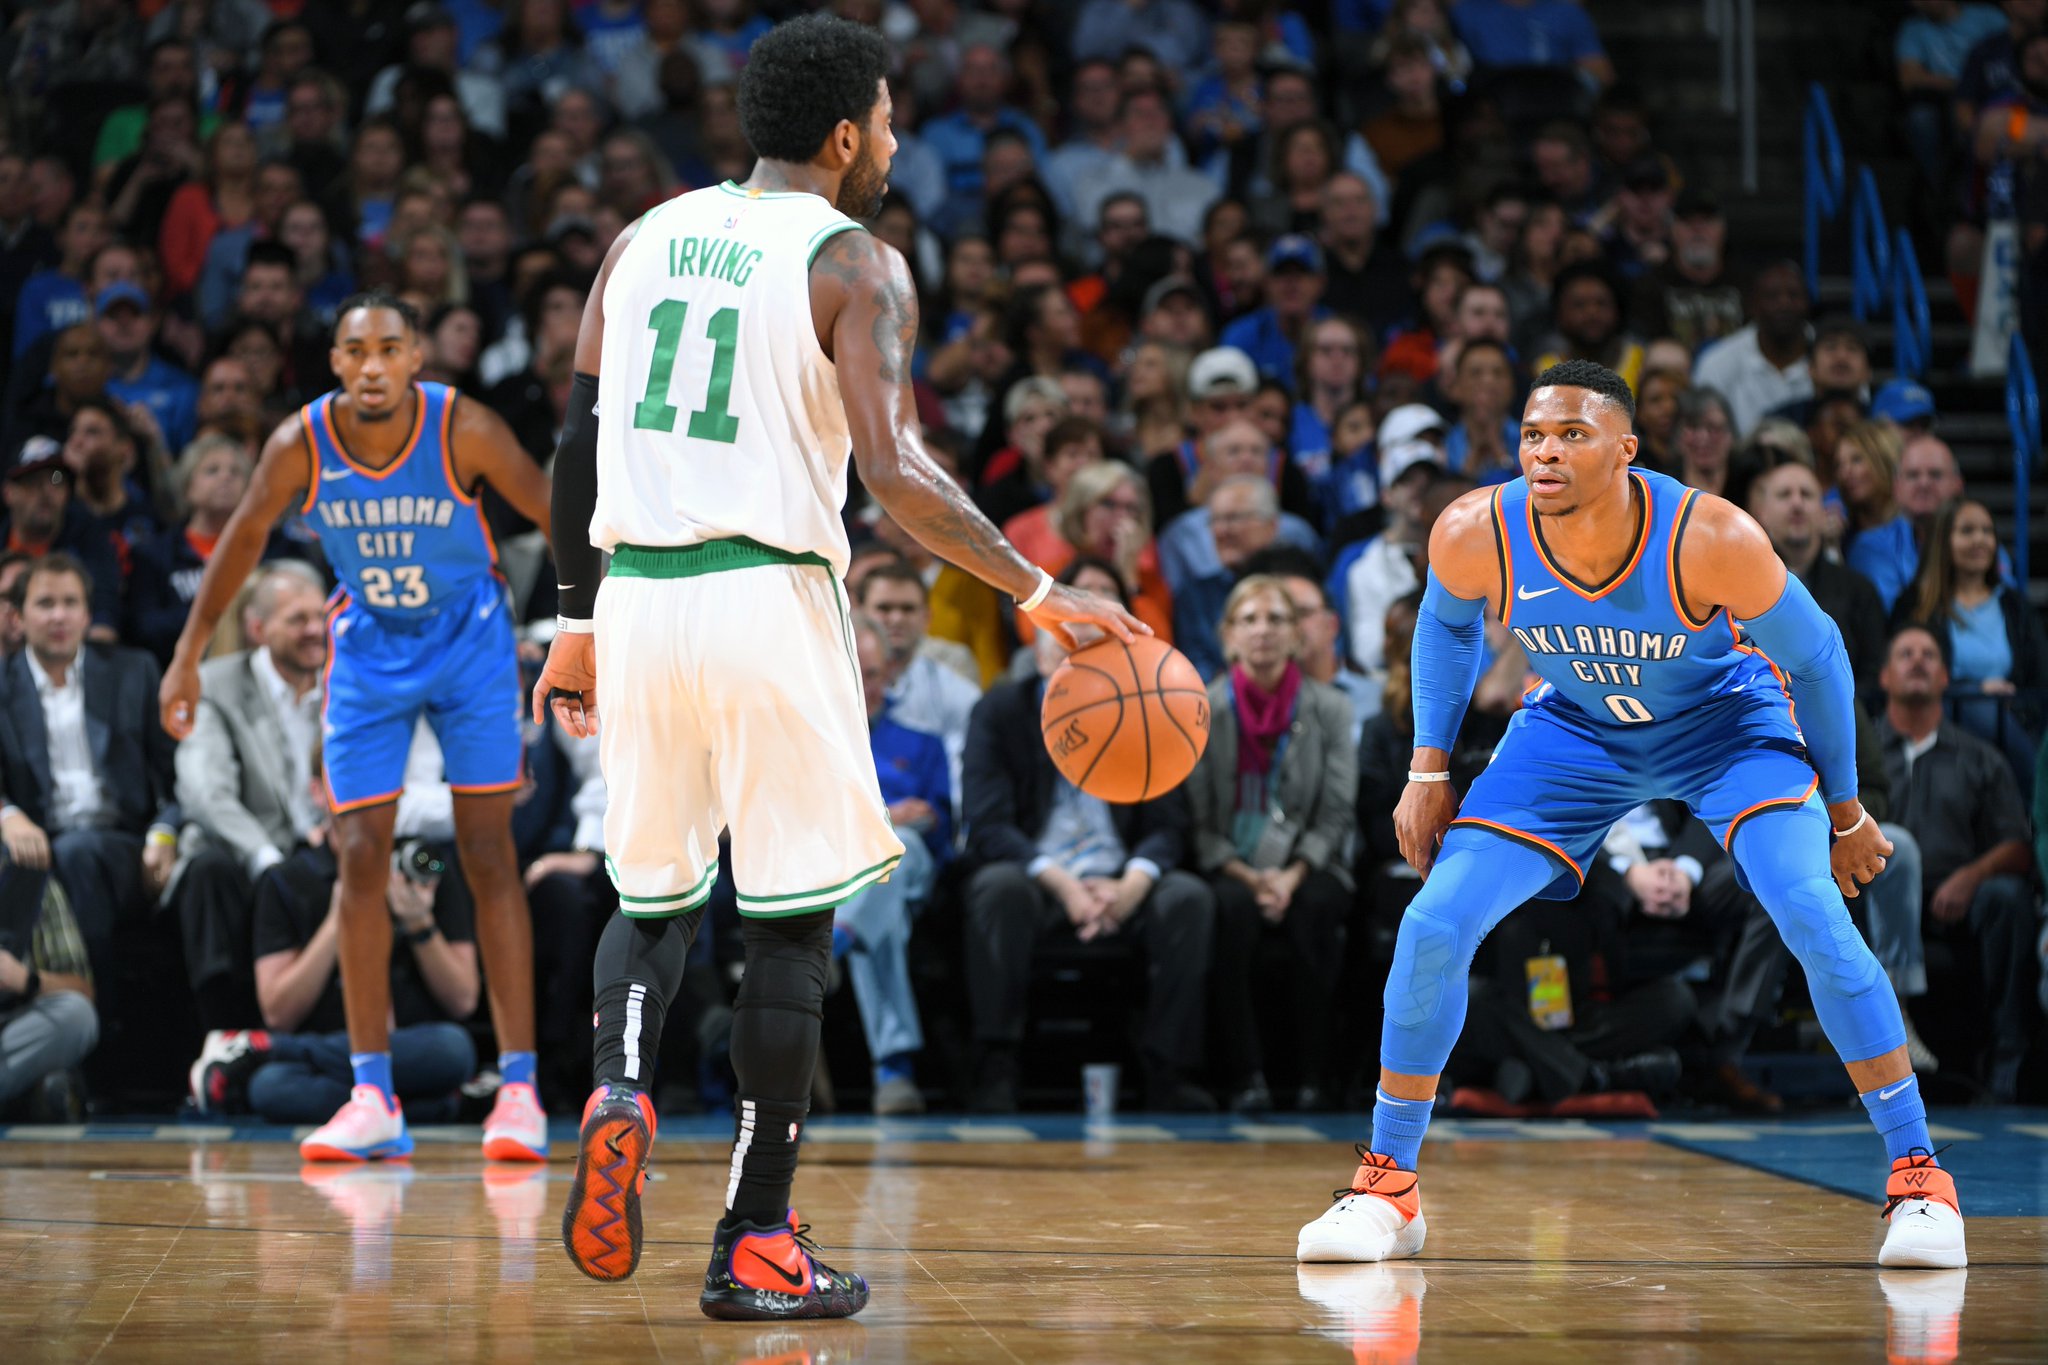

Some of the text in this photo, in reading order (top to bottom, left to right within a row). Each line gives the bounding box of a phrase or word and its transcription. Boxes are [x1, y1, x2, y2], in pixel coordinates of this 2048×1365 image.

[669, 237, 763, 288] IRVING
[633, 298, 740, 444] 11
[317, 495, 455, 528] OKLAHOMA
[356, 531, 415, 559] CITY
[360, 564, 430, 609] 23
[1511, 624, 1689, 661] OKLAHOMA
[1569, 660, 1642, 687] CITY
[1602, 693, 1656, 724] 0
